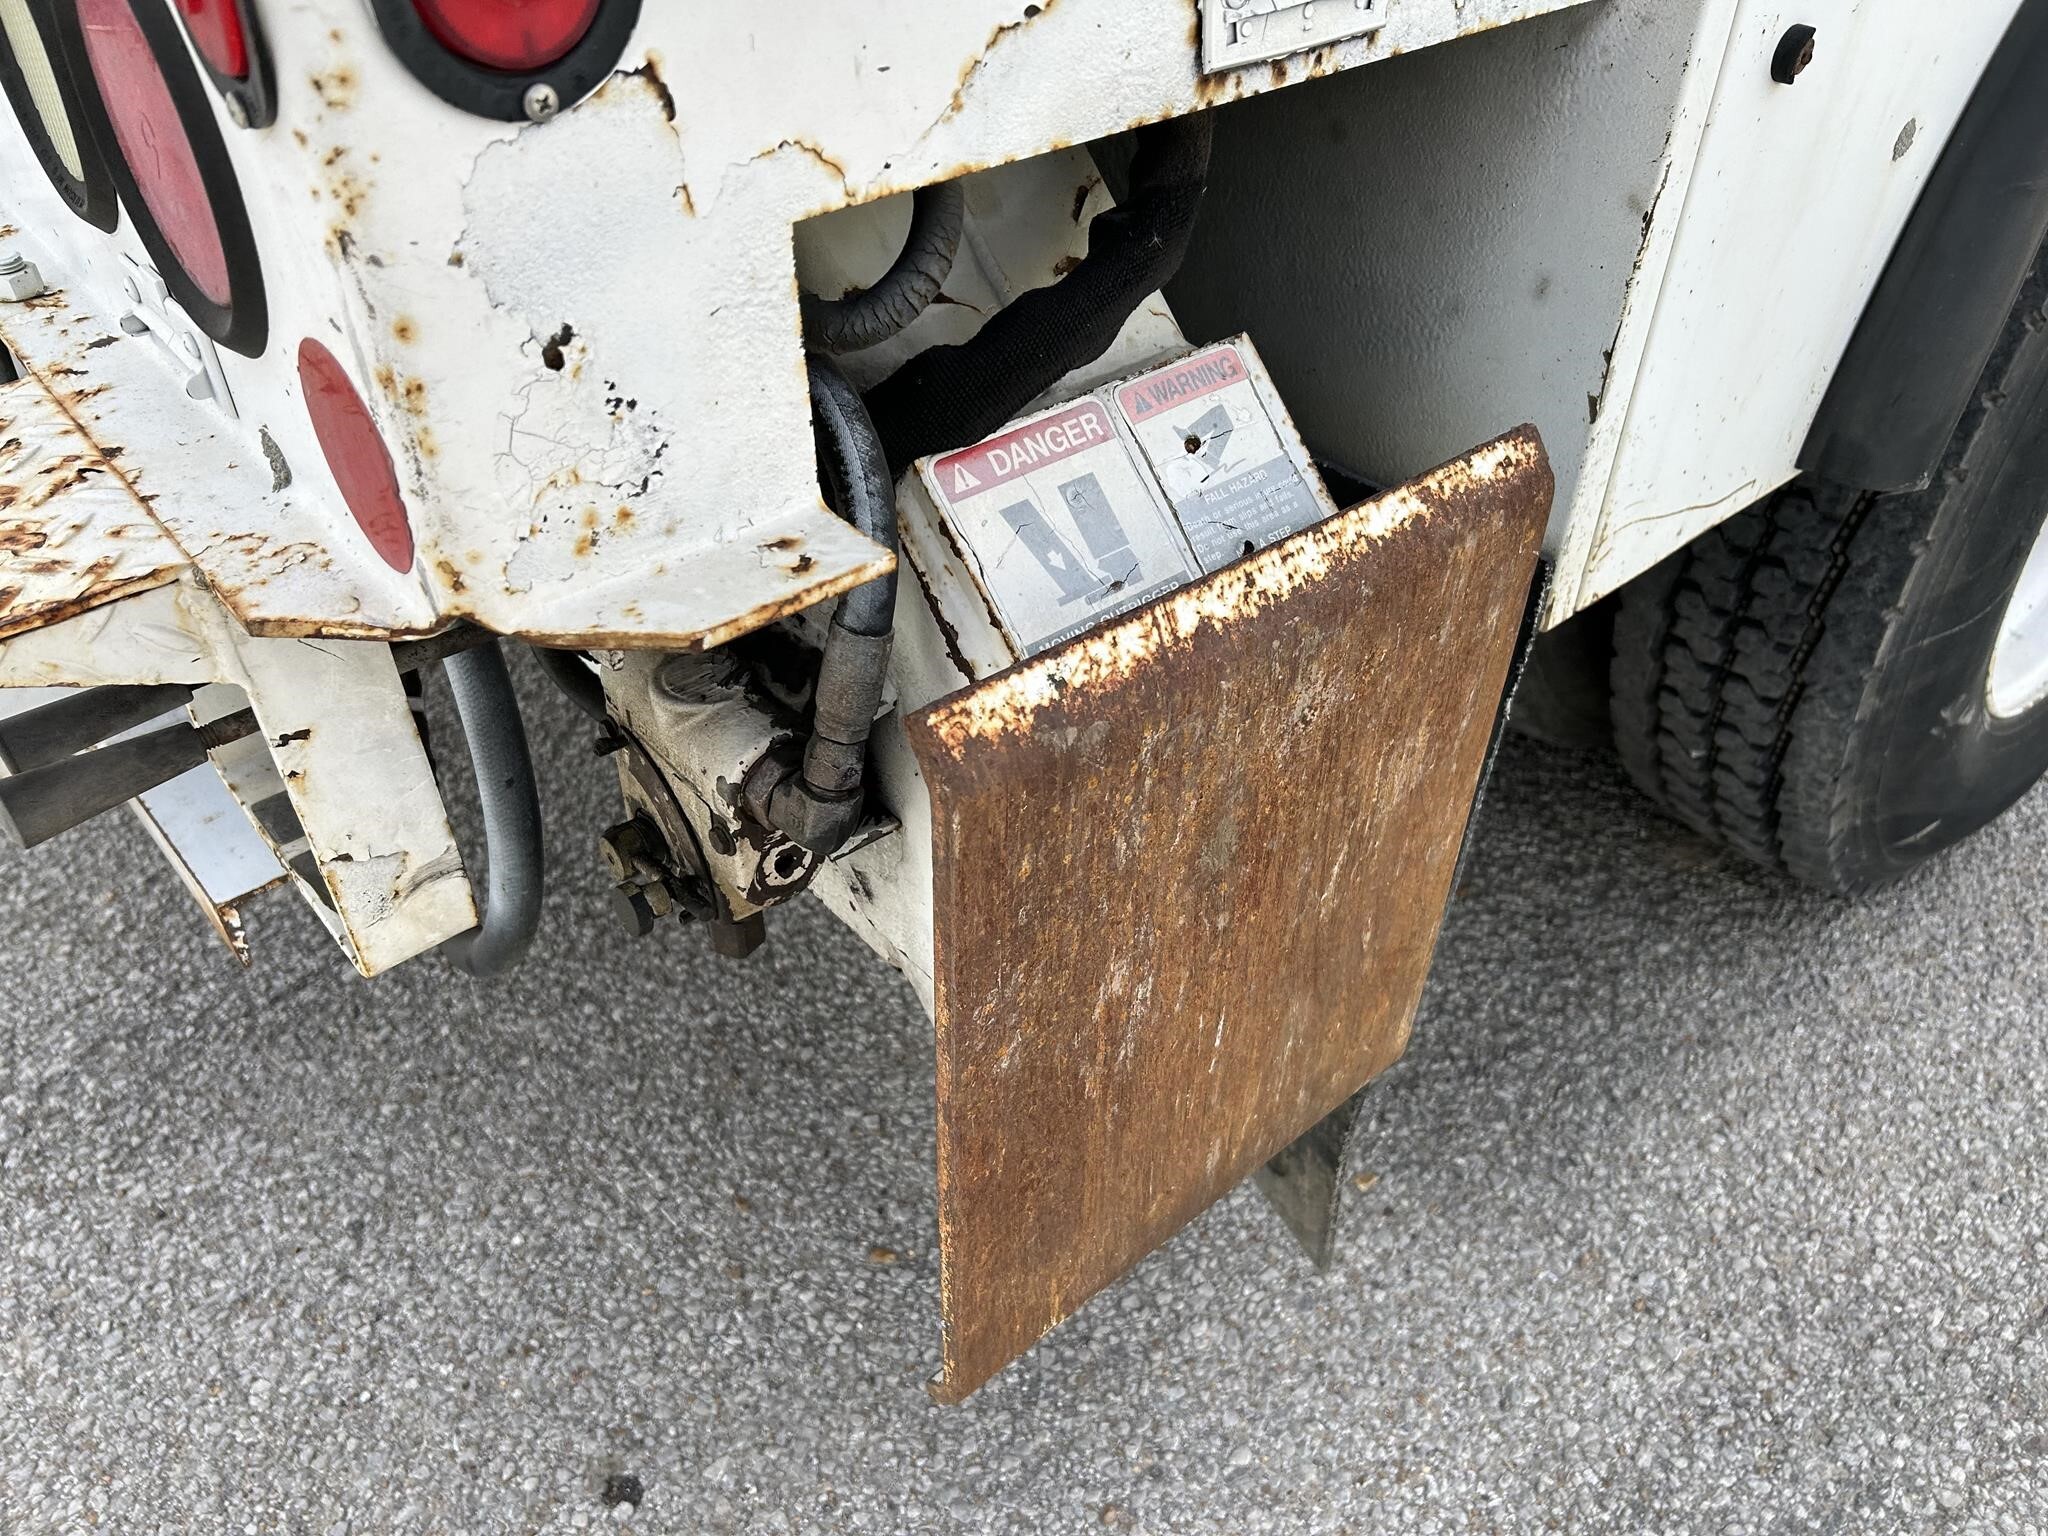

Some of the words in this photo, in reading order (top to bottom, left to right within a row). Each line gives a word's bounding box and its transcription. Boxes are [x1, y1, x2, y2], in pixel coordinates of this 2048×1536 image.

[1147, 356, 1239, 406] WARNING
[987, 411, 1105, 478] DANGER
[1203, 487, 1230, 505] FALL
[1229, 469, 1268, 495] HAZARD
[1223, 496, 1253, 514] serious
[1211, 534, 1224, 548] not
[1226, 527, 1242, 540] use
[1243, 519, 1260, 532] this
[1261, 510, 1280, 523] area
[1281, 504, 1292, 514] as
[1259, 537, 1267, 549] A
[1268, 525, 1293, 544] STEP
[1204, 550, 1225, 565] step.
